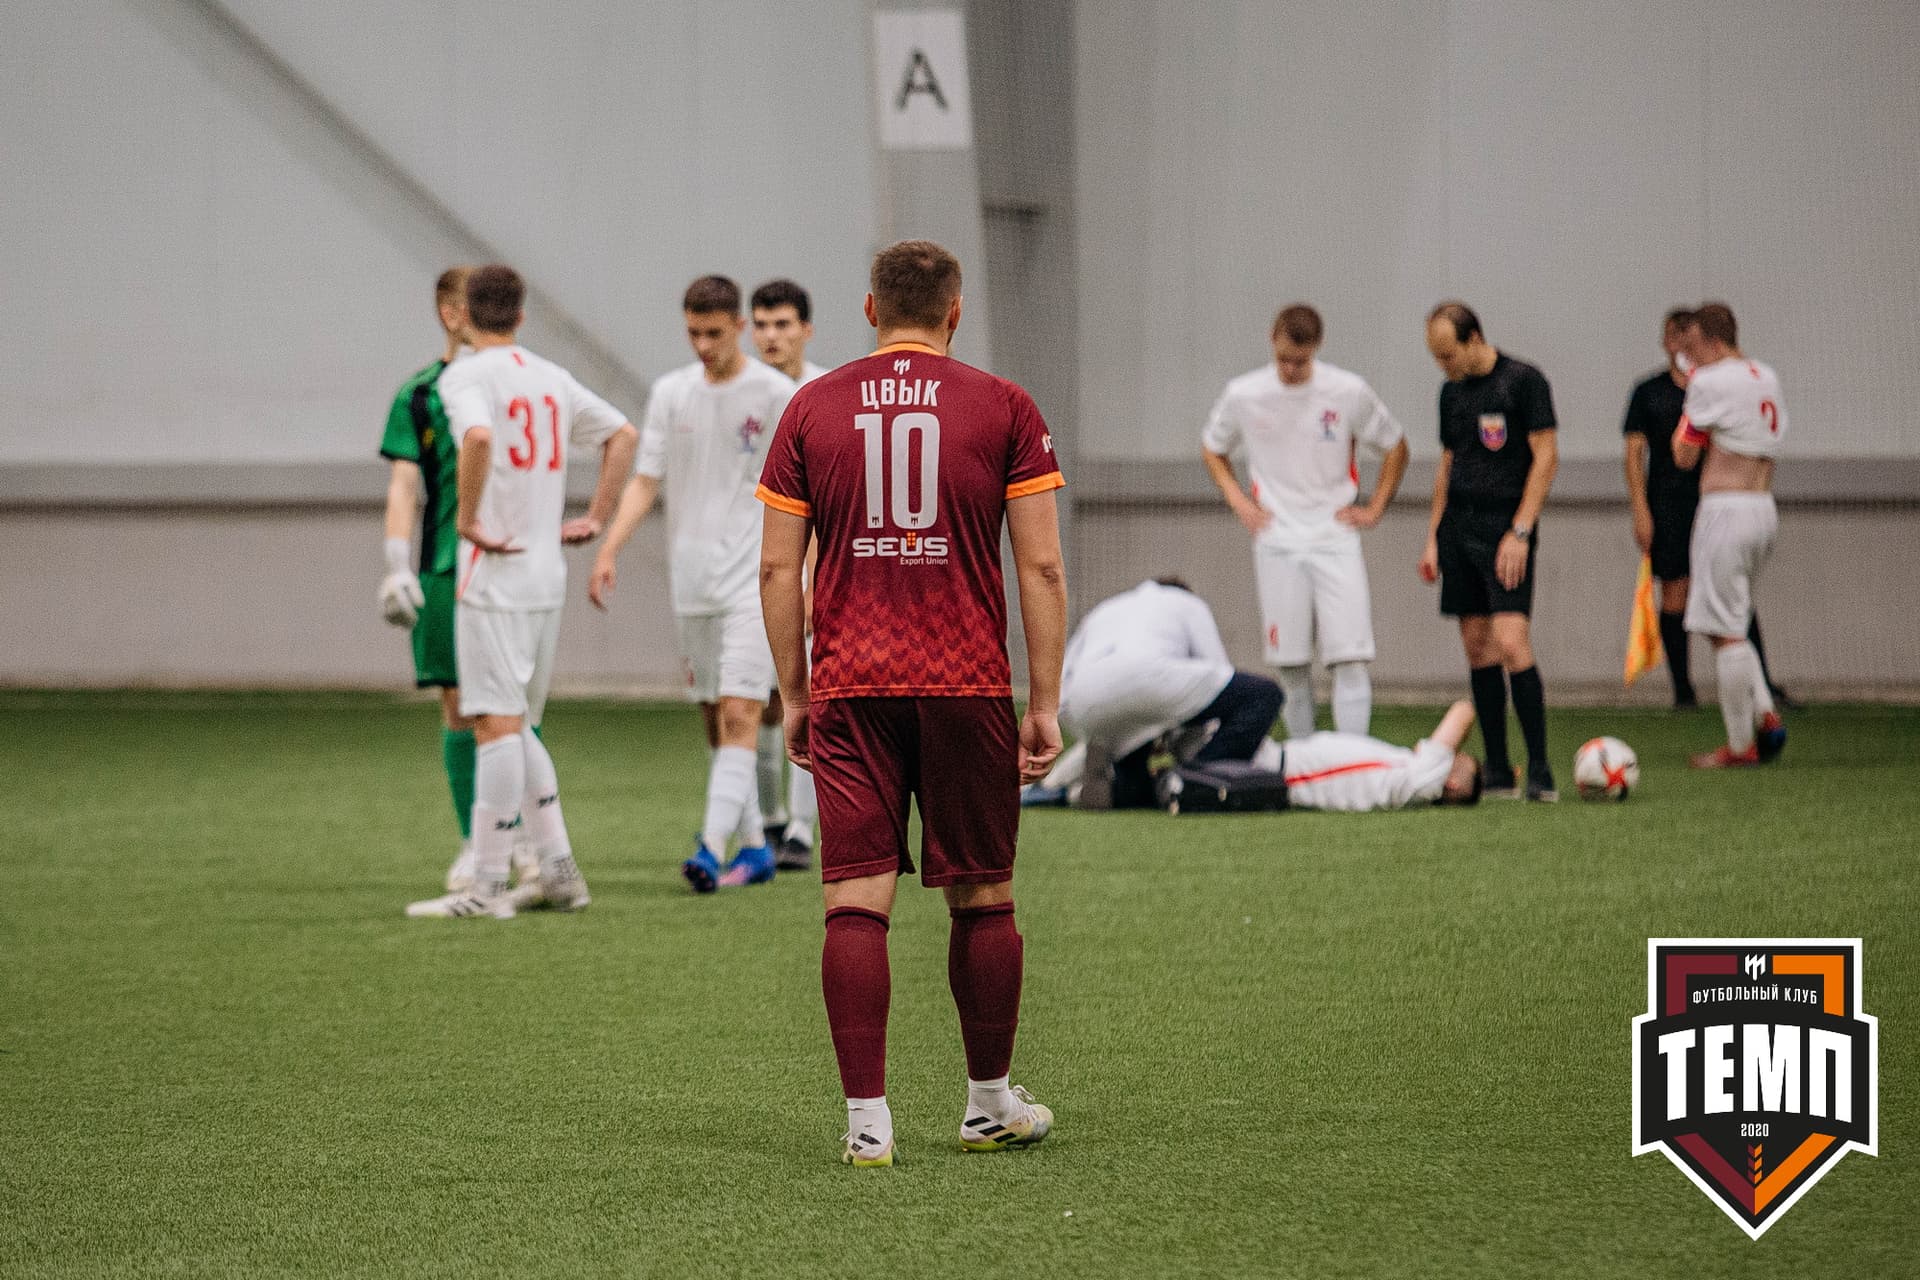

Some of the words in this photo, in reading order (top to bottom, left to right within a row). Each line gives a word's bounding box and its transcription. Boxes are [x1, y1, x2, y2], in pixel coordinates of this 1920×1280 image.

[861, 378, 942, 410] ЦВЫК
[508, 394, 562, 471] 31
[854, 412, 940, 530] 10
[852, 536, 949, 558] SEUS
[900, 557, 924, 566] Export
[926, 557, 949, 565] Union
